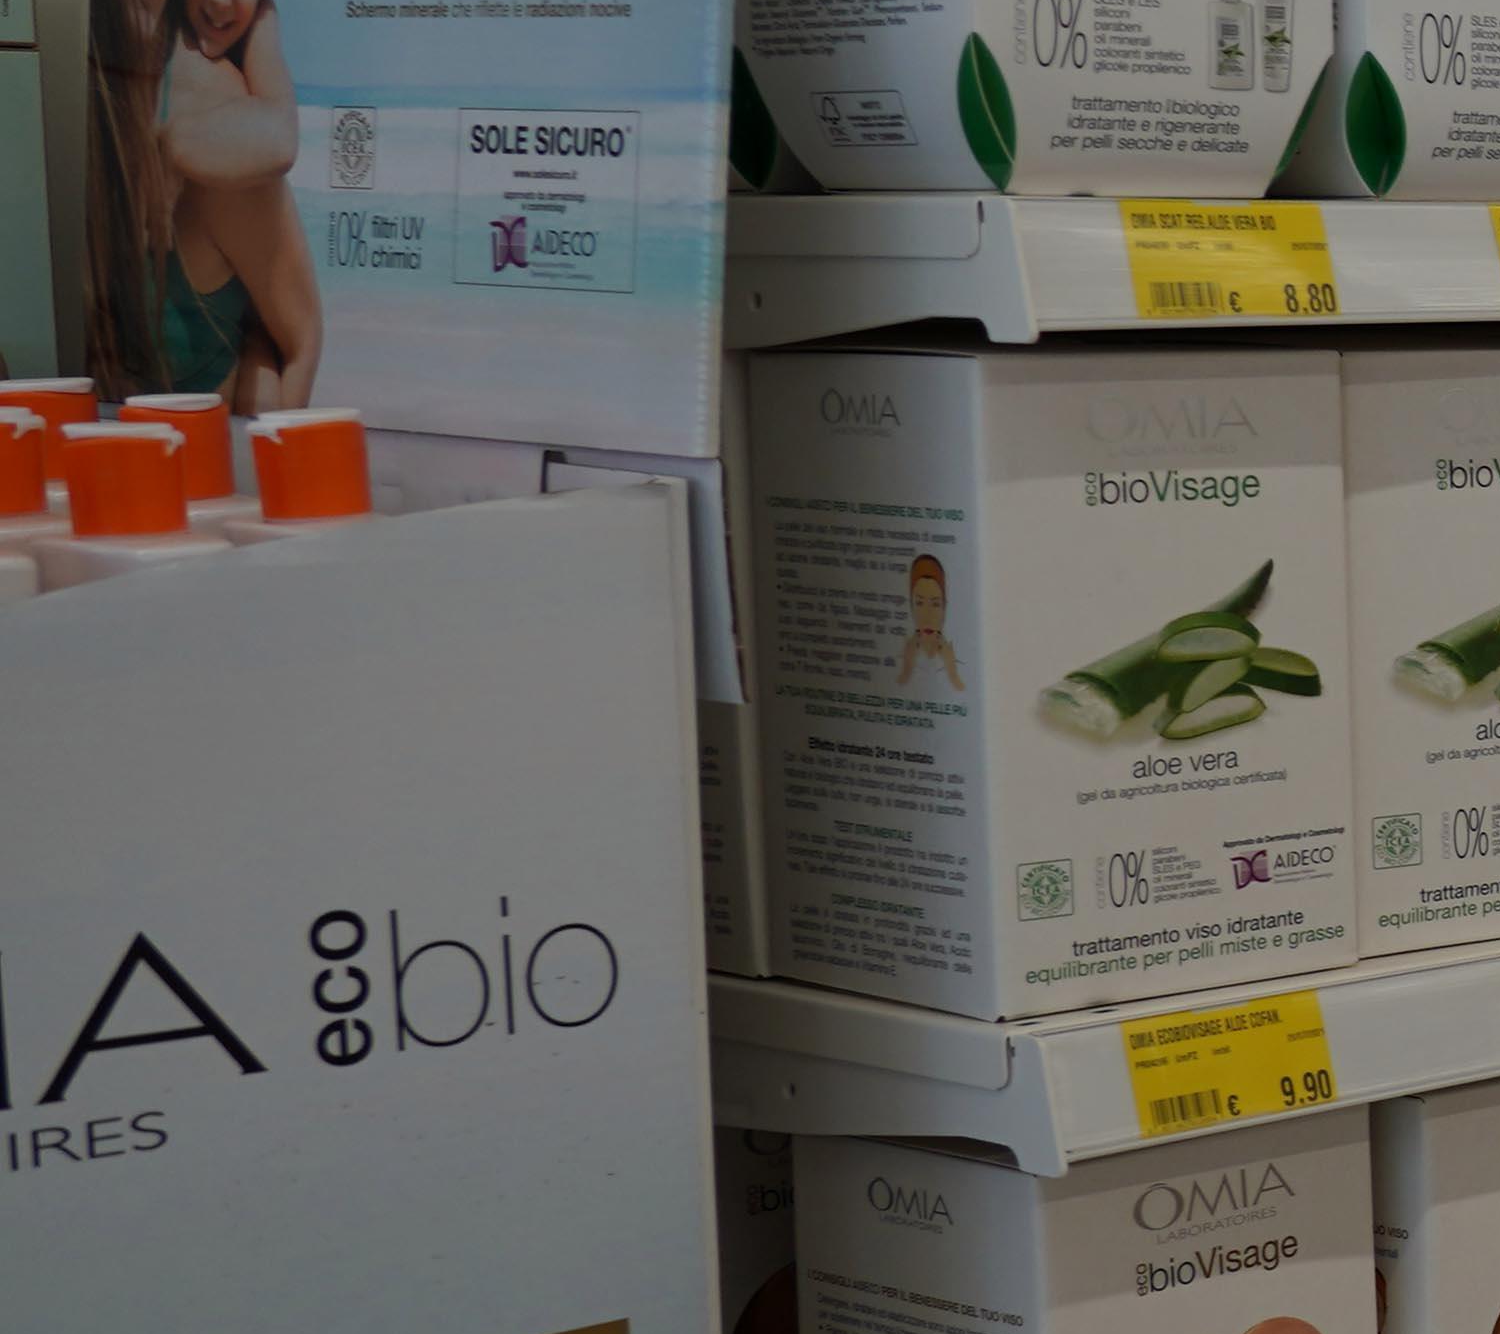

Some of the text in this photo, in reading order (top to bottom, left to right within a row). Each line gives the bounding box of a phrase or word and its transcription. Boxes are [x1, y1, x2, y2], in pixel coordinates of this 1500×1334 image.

[346, 0, 397, 18] Schermo
[400, 0, 449, 18] minerale
[525, 0, 586, 18] radiazioni
[470, 125, 529, 156] SOLE
[336, 209, 425, 269] 0% filtri UV
[371, 245, 422, 270] chimici
[1099, 467, 1261, 507] bioVisage
[1132, 749, 1240, 780] aloe vera
[1108, 849, 1149, 909] 0%
[1025, 923, 1344, 985] equilibrante per pelli miste e grasse
[1072, 908, 1304, 958] trattamento viso idratante
[306, 908, 374, 1066] eco
[388, 894, 619, 1053] bio
[1226, 1069, 1333, 1117] € 9.90
[1156, 1205, 1278, 1245] LABORATOIRES
[1148, 1233, 1299, 1294] bioVisage
